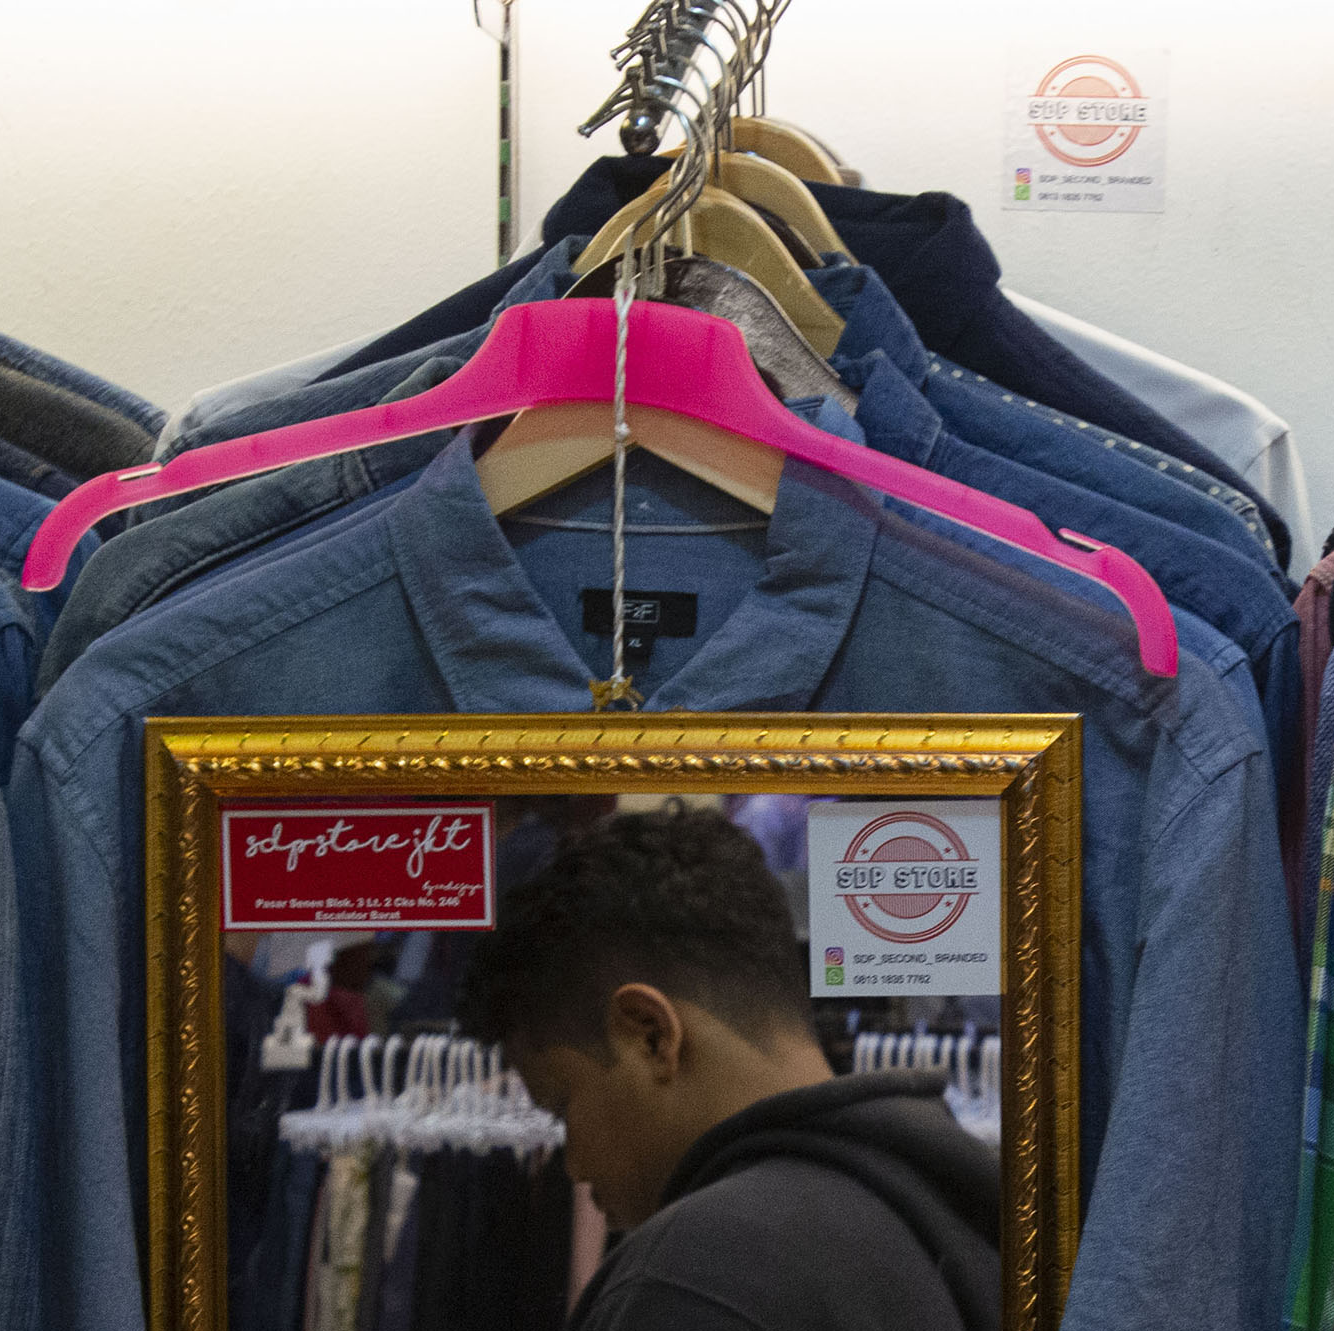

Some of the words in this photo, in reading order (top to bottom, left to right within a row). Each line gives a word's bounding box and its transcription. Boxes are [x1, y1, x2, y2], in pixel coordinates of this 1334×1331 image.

[1078, 102, 1147, 122] STORE
[836, 866, 886, 889] SDP
[894, 866, 978, 889] STORE
[384, 897, 393, 907] 2
